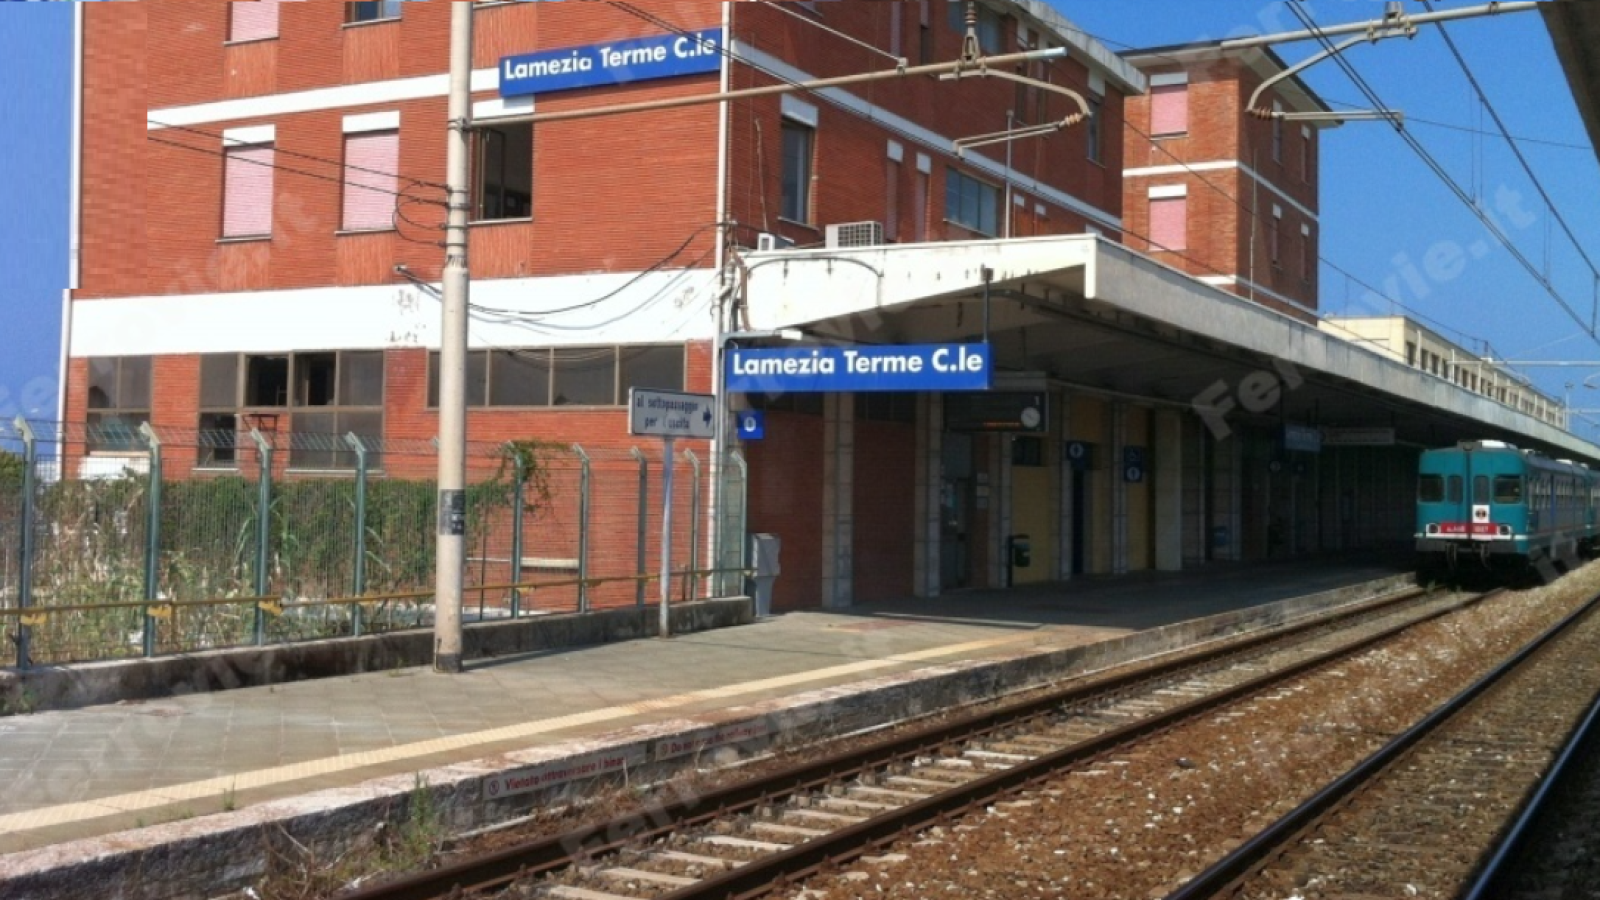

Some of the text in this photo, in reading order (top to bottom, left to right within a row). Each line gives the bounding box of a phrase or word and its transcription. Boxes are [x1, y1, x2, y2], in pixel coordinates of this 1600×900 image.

[504, 33, 716, 80] Lamezia Terme C.le
[733, 346, 983, 375] Lamezia Terme C.le
[644, 416, 657, 429] per
[505, 775, 539, 790] Vietato
